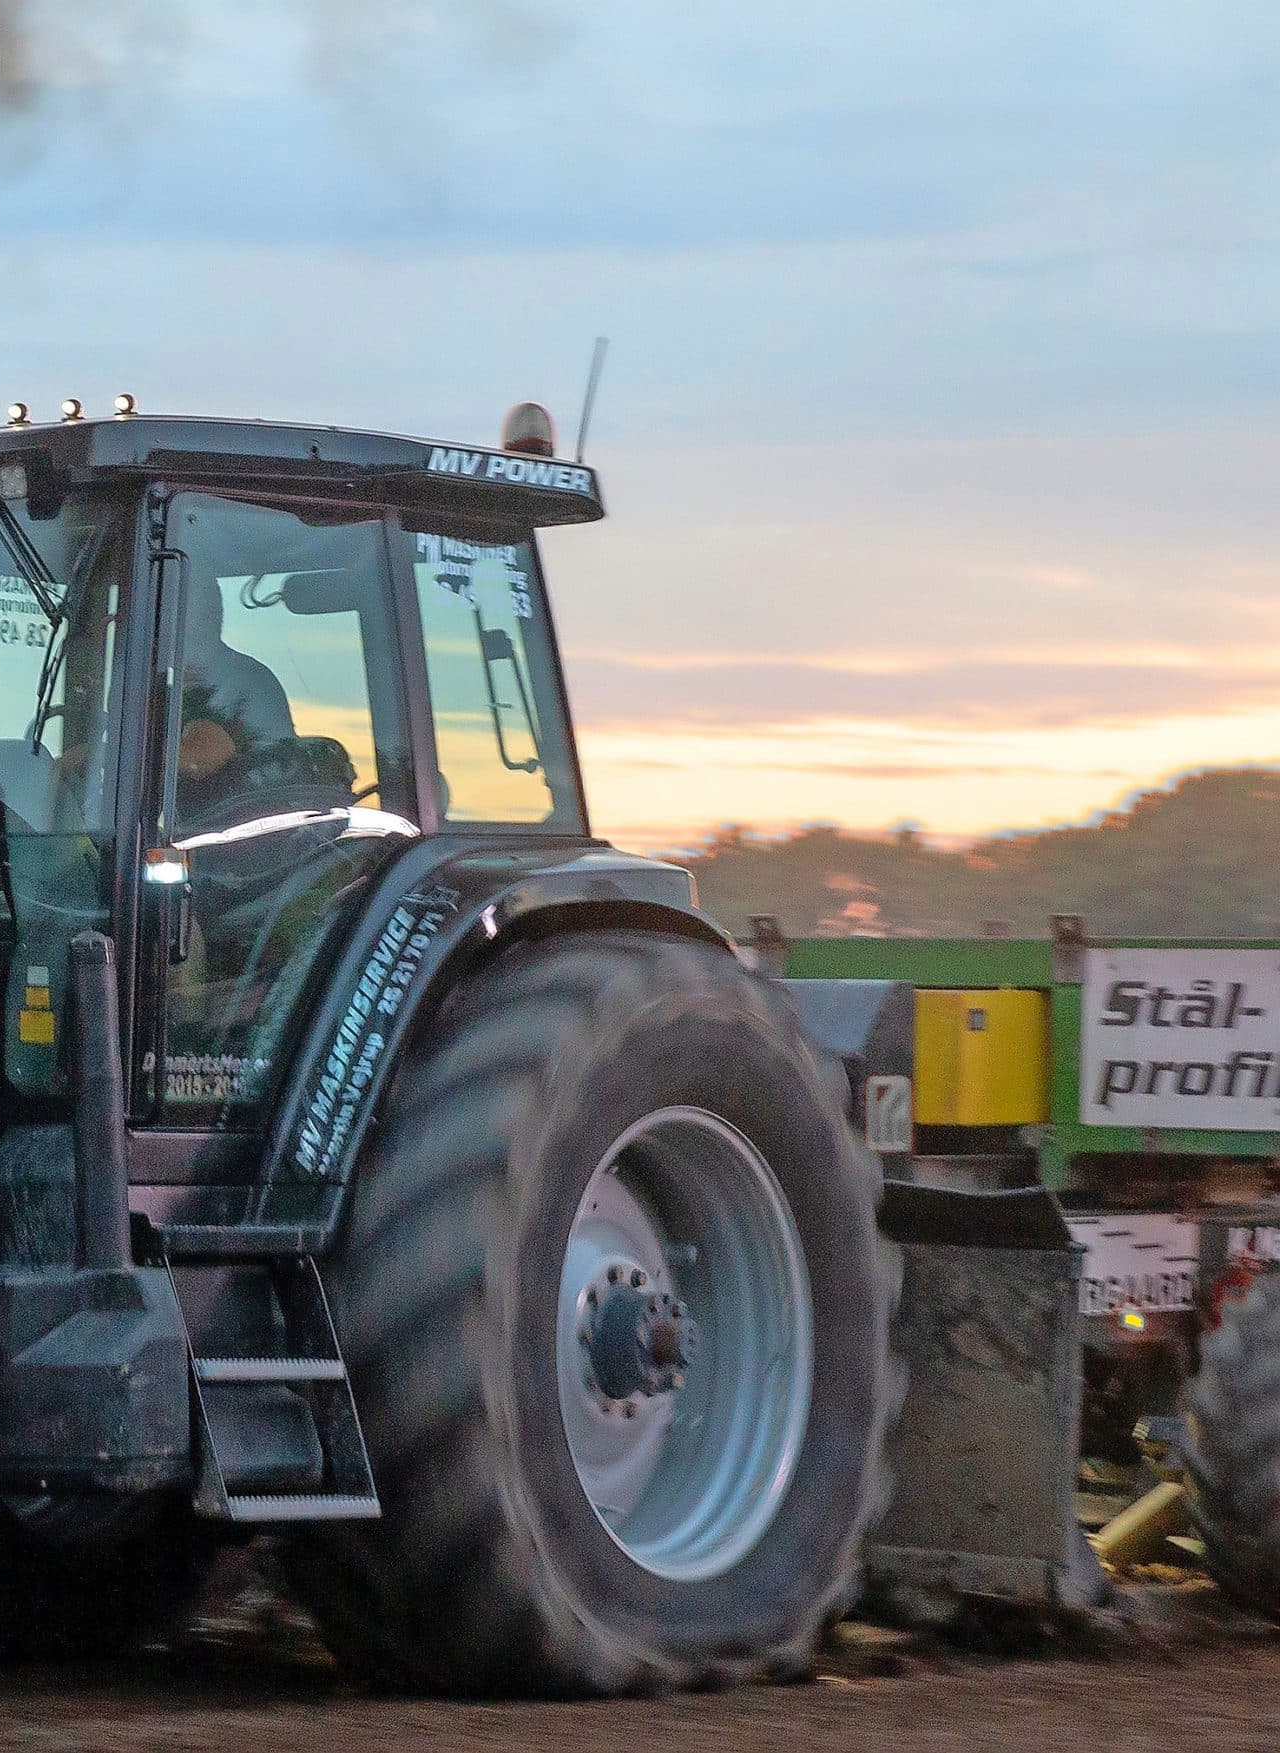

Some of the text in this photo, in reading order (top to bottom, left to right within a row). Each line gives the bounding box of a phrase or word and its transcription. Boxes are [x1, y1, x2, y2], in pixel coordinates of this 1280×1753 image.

[427, 447, 592, 492] MV POWER
[1098, 979, 1265, 1029] Stål-
[296, 905, 416, 1173] MV MASKINSERVICE
[341, 1032, 385, 1103] Vejrup
